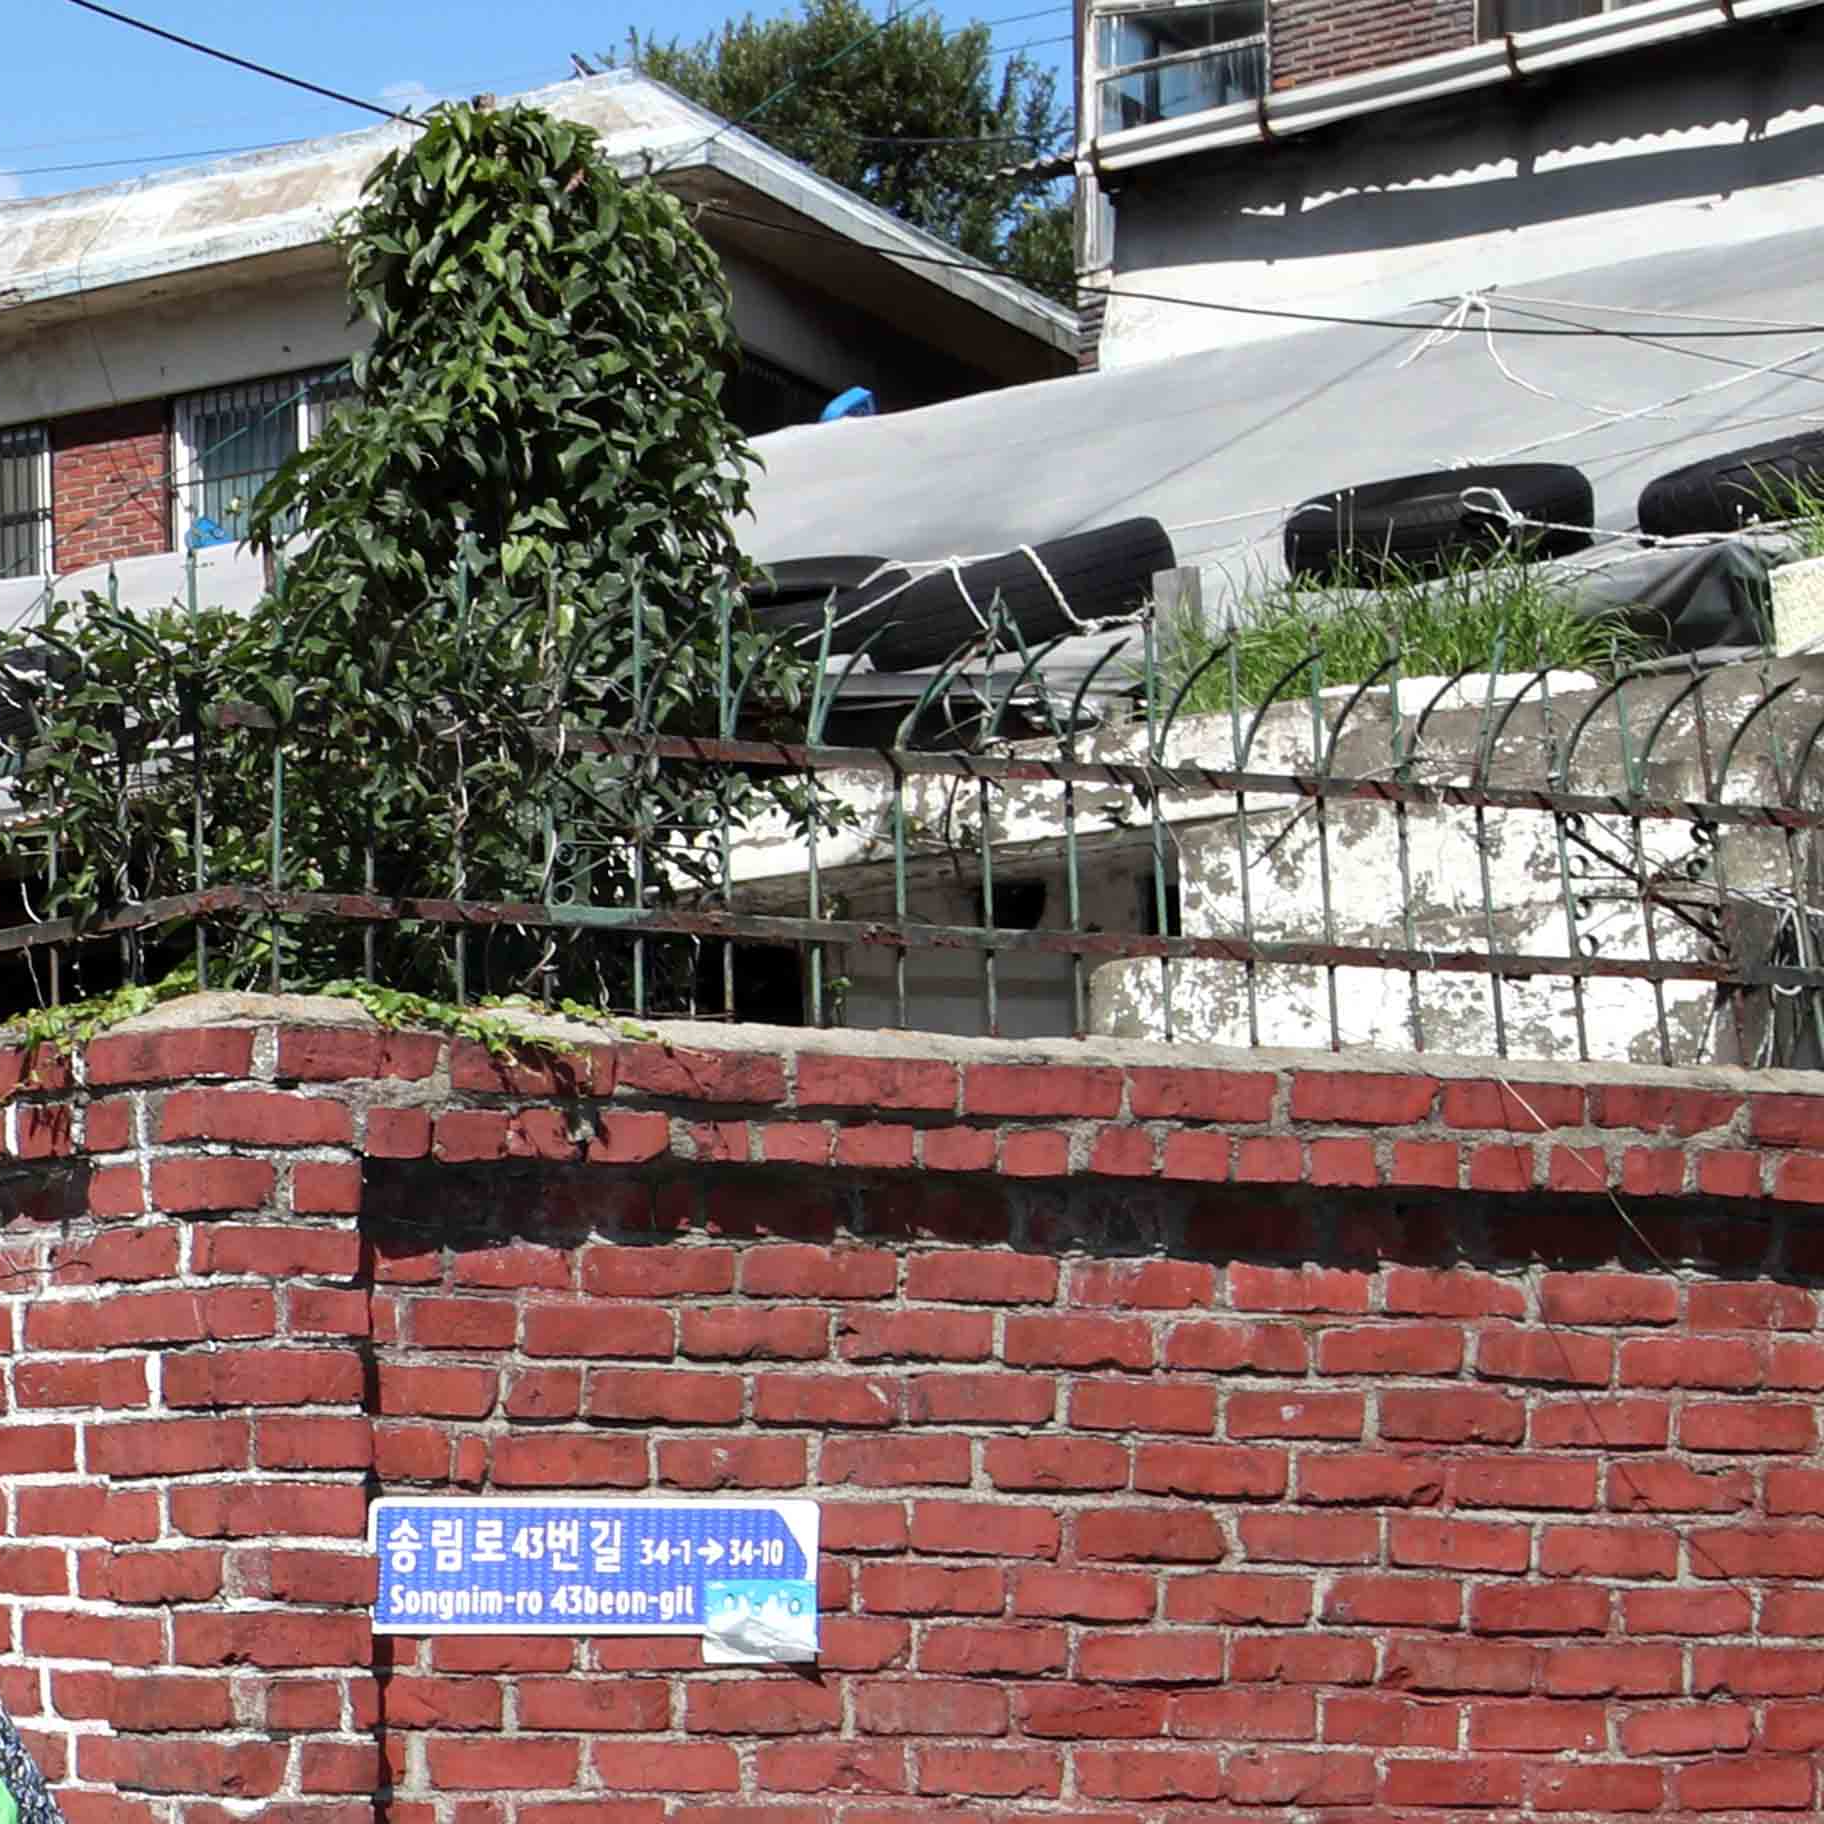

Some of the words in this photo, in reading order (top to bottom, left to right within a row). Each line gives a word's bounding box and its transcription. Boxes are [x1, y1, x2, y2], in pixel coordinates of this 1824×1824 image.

[387, 1518, 620, 1572] 송림로43번길
[639, 1538, 692, 1565] 34-1
[728, 1538, 785, 1566] 34-10
[389, 1584, 543, 1620] Songnim-ro
[550, 1585, 695, 1620] 43beon-gil
